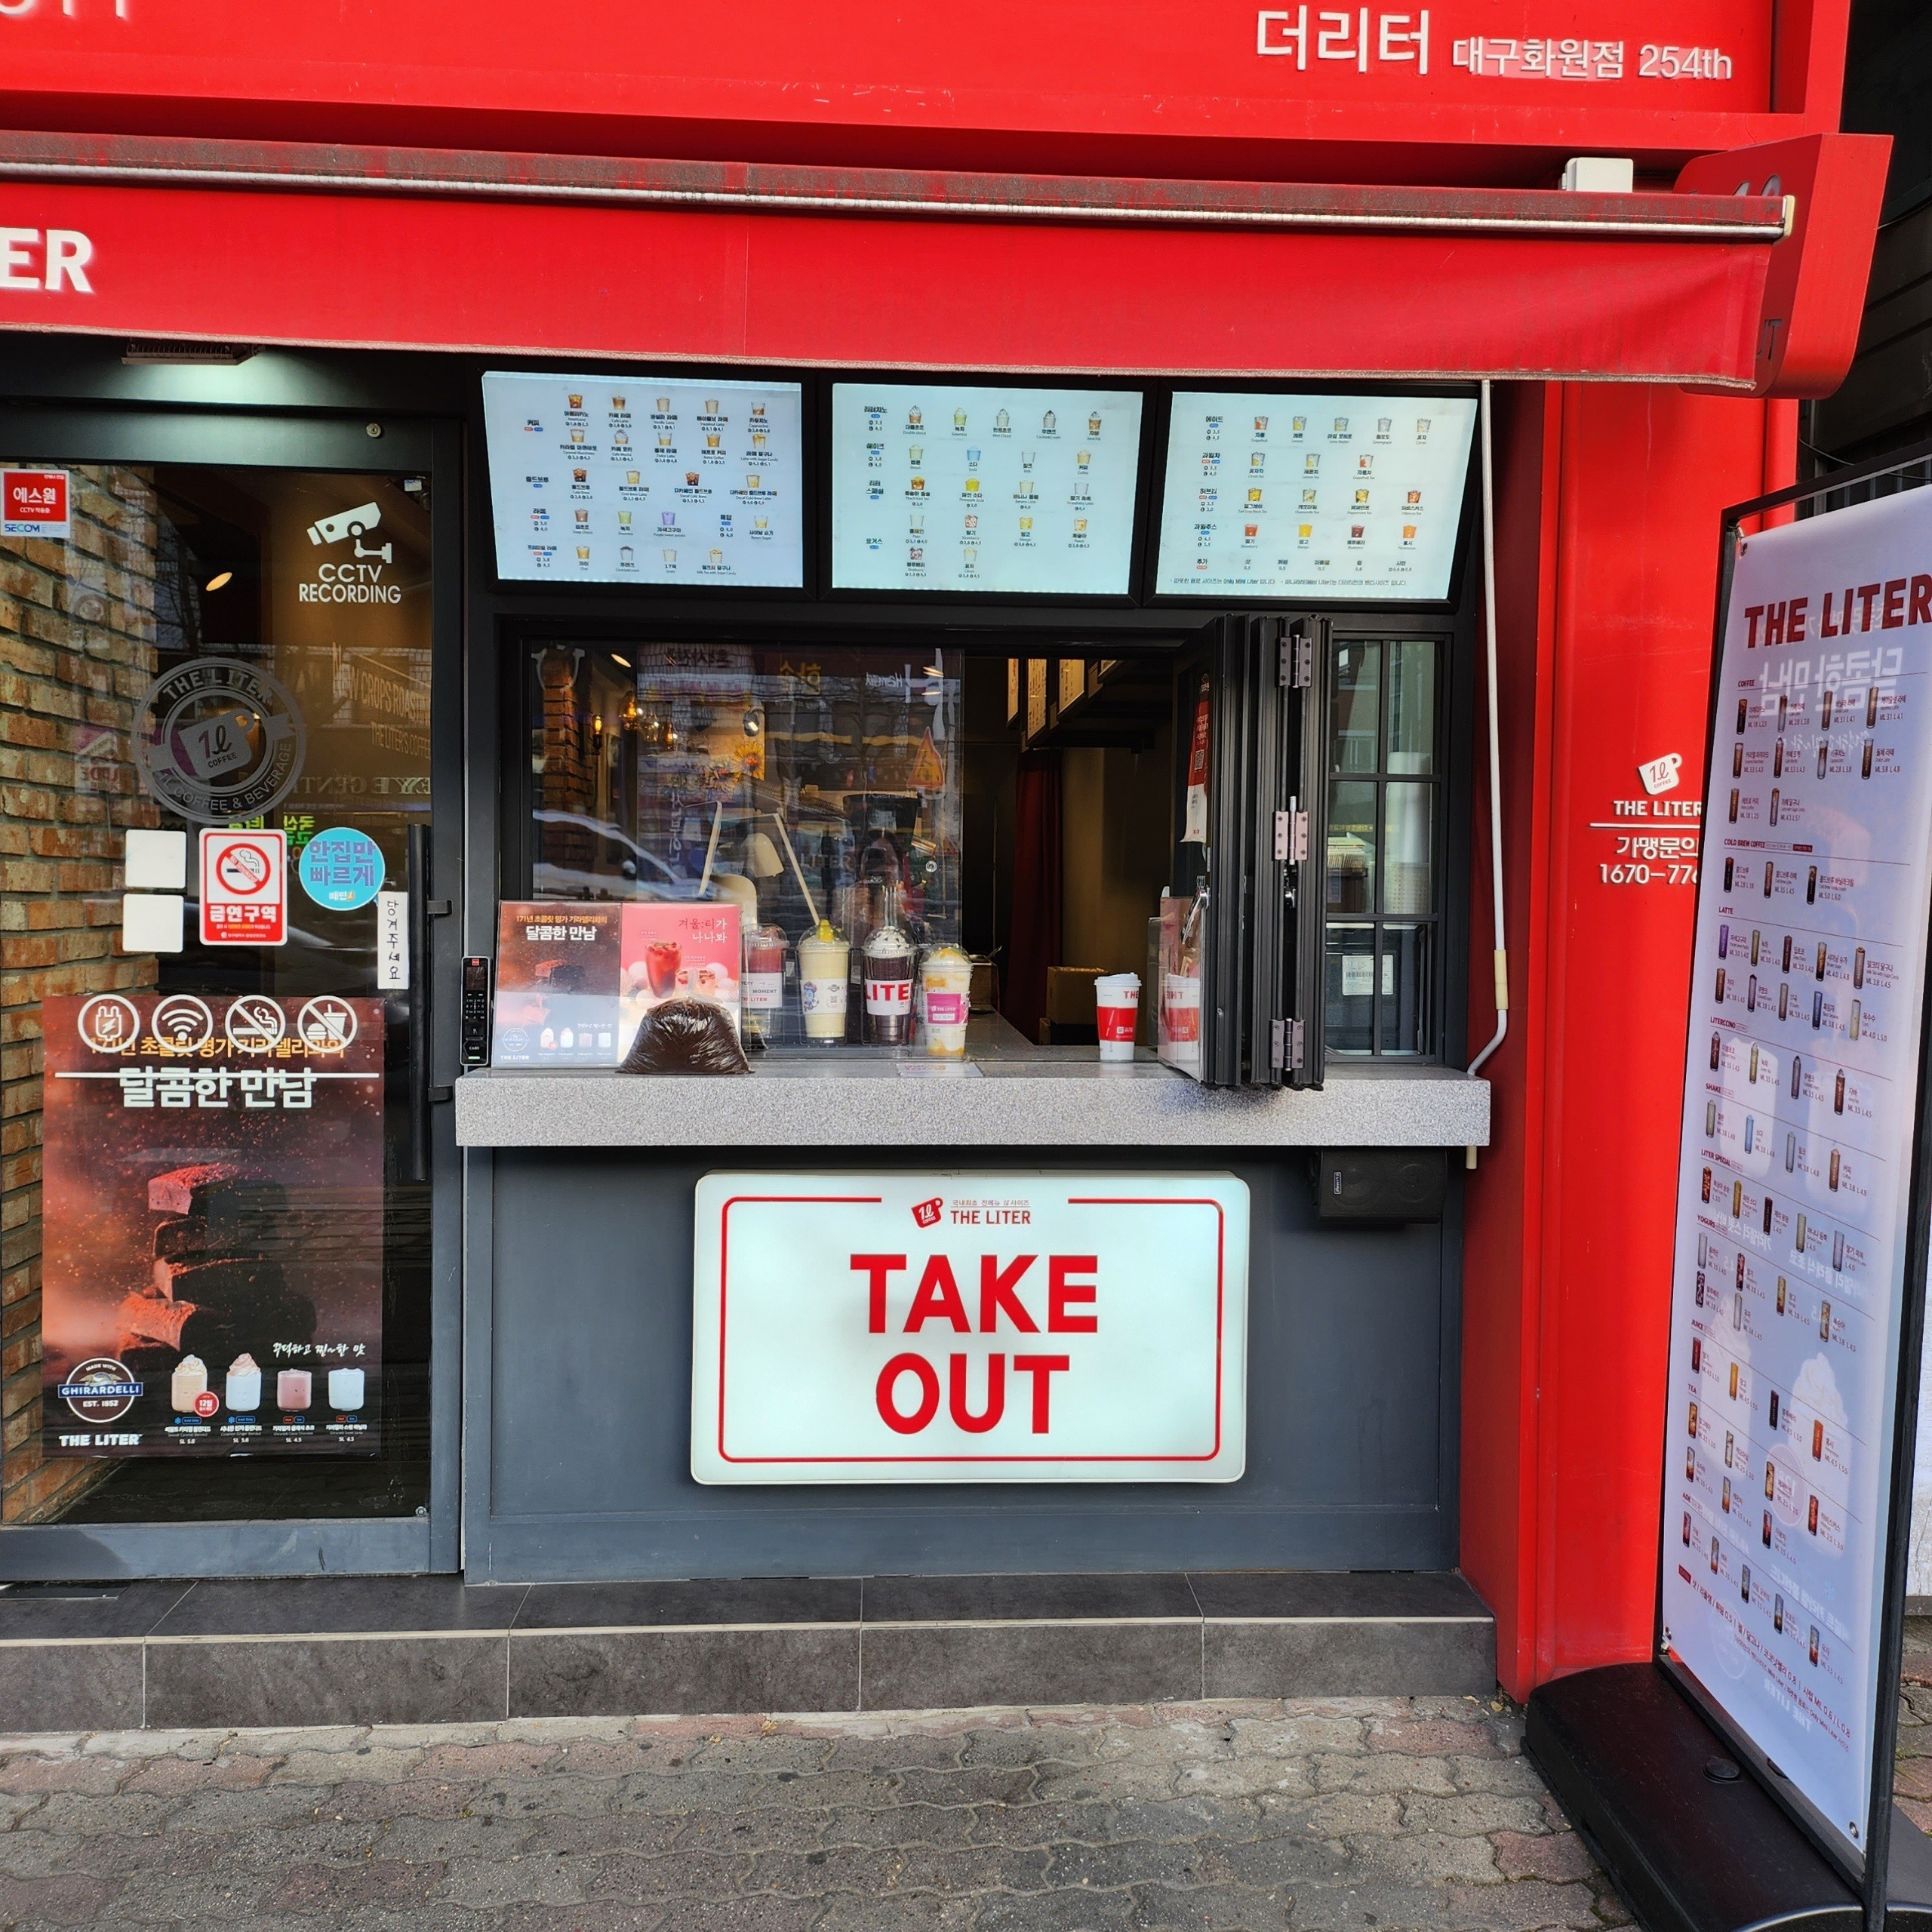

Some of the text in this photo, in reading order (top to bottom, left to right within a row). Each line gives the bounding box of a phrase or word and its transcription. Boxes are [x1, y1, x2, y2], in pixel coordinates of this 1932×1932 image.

[1257, 5, 1733, 80] 더리터 대구화원점 254th
[13, 487, 57, 504] 에스원
[5, 524, 40, 532] SECOM
[318, 563, 382, 583] CCTV
[299, 583, 401, 604] RECORDING
[1745, 574, 1932, 649] THE LITER
[162, 668, 274, 703] THE LITER
[1738, 679, 1755, 688] COFFEE
[208, 752, 238, 768] COFFEE
[174, 786, 228, 811] COFFEE
[232, 797, 242, 809] &
[245, 743, 291, 805] BEVERAGE
[1654, 779, 1672, 789] COFFEE
[1614, 800, 1647, 816] THE
[309, 840, 377, 863] 한집만
[1617, 837, 1700, 860] 가맹문의
[310, 866, 374, 887] 빠르게
[210, 905, 277, 923] 금연구역
[1718, 906, 1734, 915] LATTE
[525, 925, 597, 941] 달콤한 만남
[1710, 1017, 1736, 1029] LITERCCINO
[118, 1066, 318, 1109] 달콤한 만남
[1706, 1083, 1721, 1094] SHAKE
[1701, 1149, 1731, 1166] LITER SPECIAL
[950, 1210, 1031, 1224] THE LITER
[1697, 1214, 1715, 1228] YOGURS
[850, 1254, 1098, 1334] TAKE
[1691, 1319, 1703, 1331] JUICE
[273, 1342, 312, 1358] 꾸덕하고
[352, 1343, 366, 1357] 맛
[85, 1363, 102, 1371] MADE
[61, 1386, 140, 1395] GHIRARDELLI
[875, 1352, 1070, 1435] OUT
[1687, 1383, 1697, 1394] TEA
[58, 1434, 141, 1447] THE LITER
